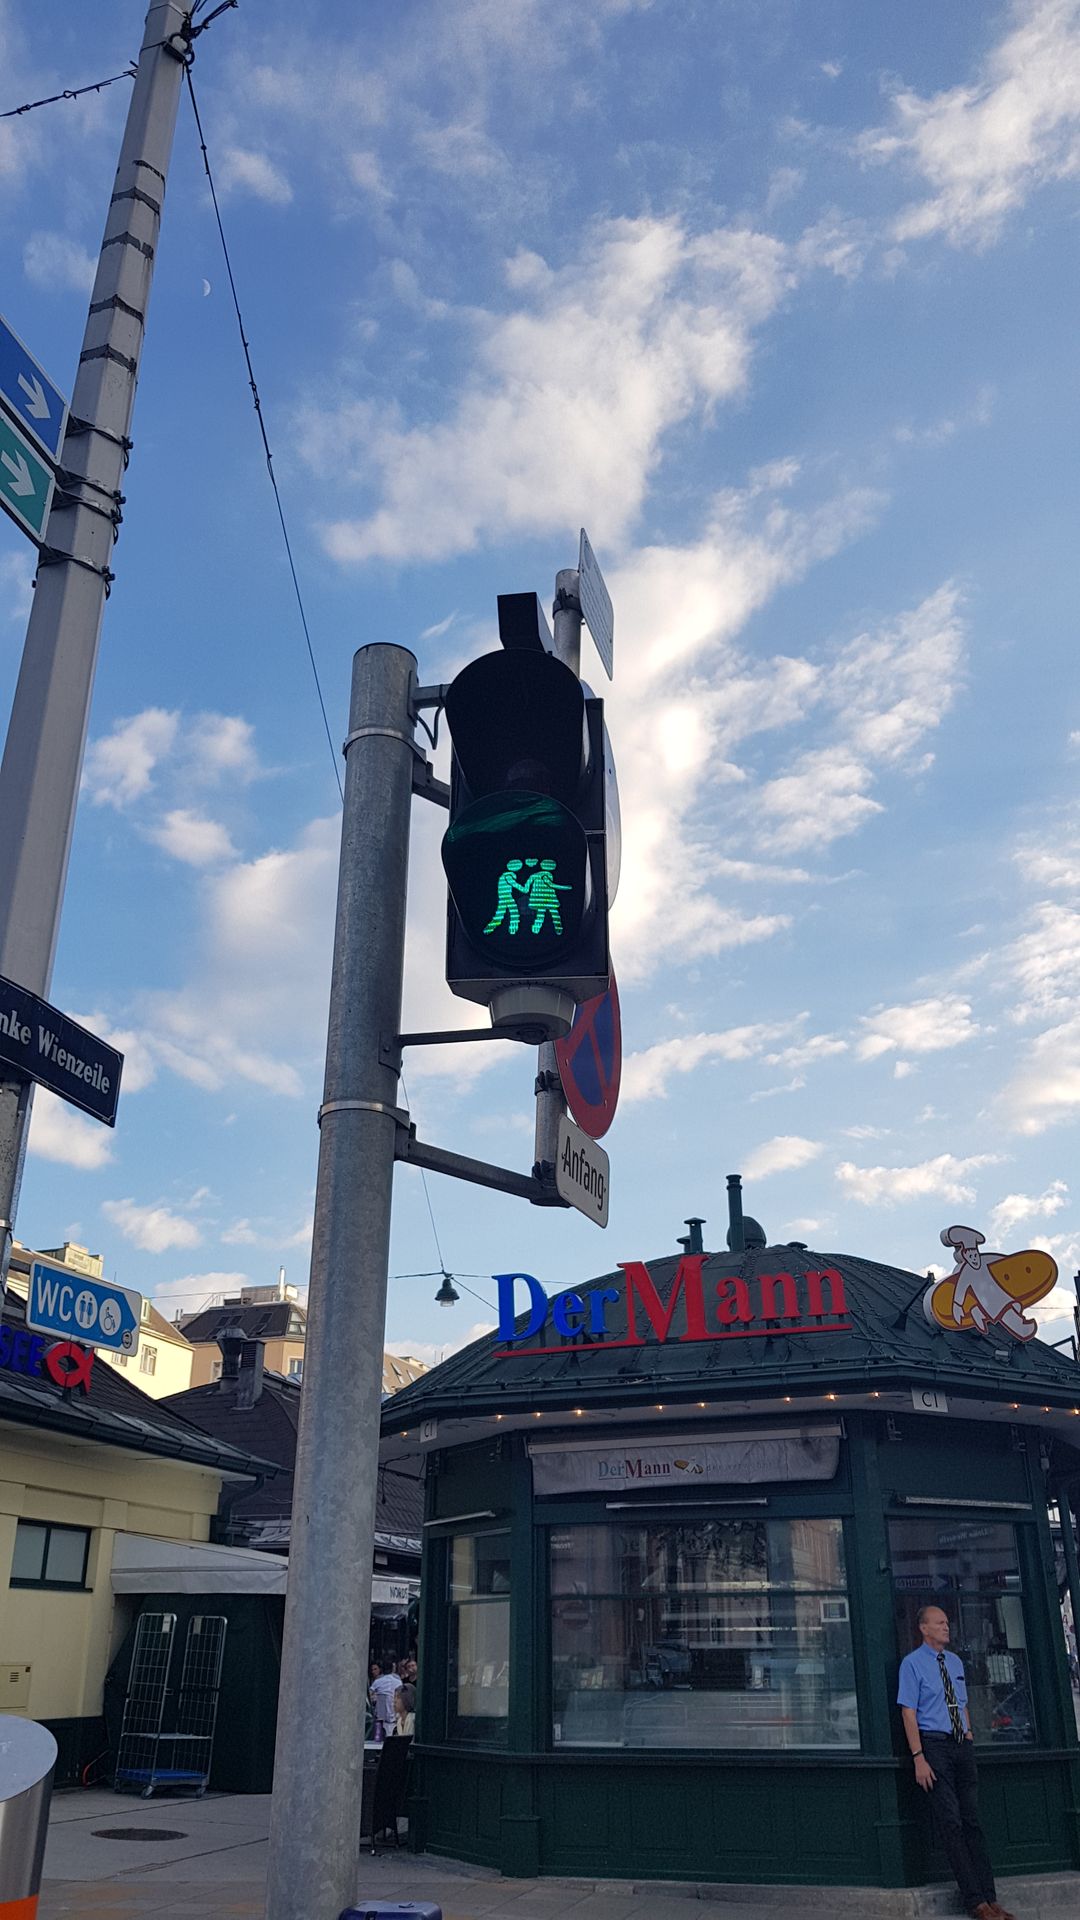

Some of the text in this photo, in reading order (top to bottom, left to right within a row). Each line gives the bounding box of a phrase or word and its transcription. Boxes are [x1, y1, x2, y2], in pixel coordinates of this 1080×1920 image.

[38, 1025, 110, 1095] Wienzeile
[563, 1136, 605, 1211] Anfang
[37, 1276, 74, 1322] WC
